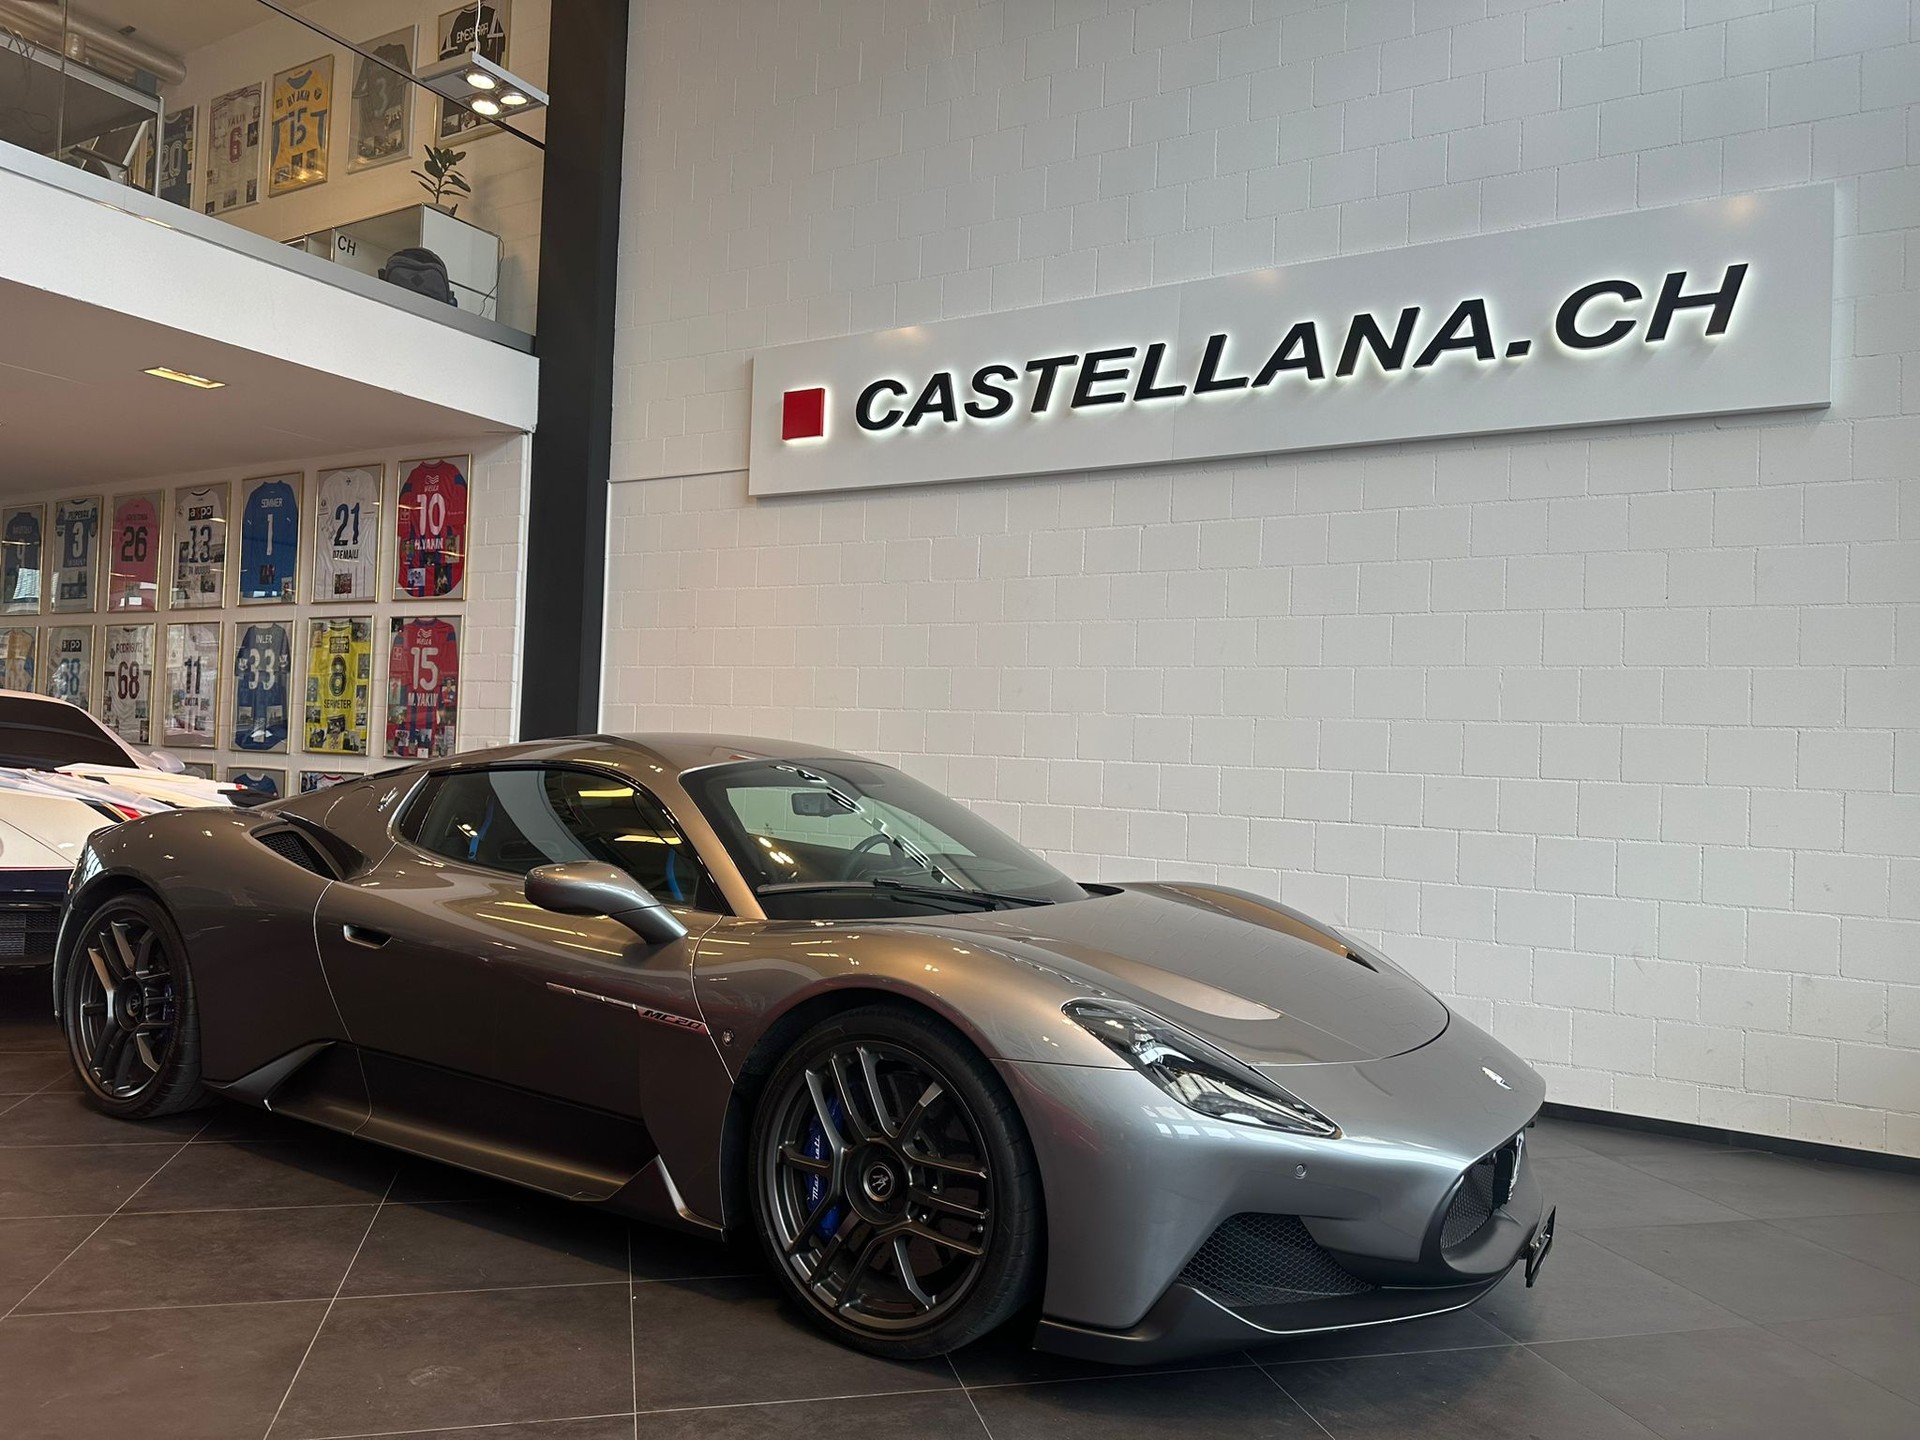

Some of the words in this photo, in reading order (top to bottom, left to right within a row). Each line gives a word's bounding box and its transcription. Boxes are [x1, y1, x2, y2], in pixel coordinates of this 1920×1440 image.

[229, 127, 242, 163] 6
[288, 107, 307, 146] 15
[338, 236, 356, 256] CH
[855, 263, 1748, 431] CASTELLANA.CH
[261, 498, 282, 508] SOMMER
[417, 493, 445, 535] 10
[72, 522, 84, 558] 3
[266, 514, 273, 555] 1
[334, 502, 359, 546] 21
[121, 526, 148, 562] 26
[189, 525, 211, 563] 13
[256, 634, 272, 644] INLER
[118, 661, 139, 699] 68
[184, 656, 201, 694] 11
[248, 648, 275, 690] 33
[329, 655, 347, 697] 8
[410, 647, 438, 690] 15
[643, 1010, 702, 1029] MC20
